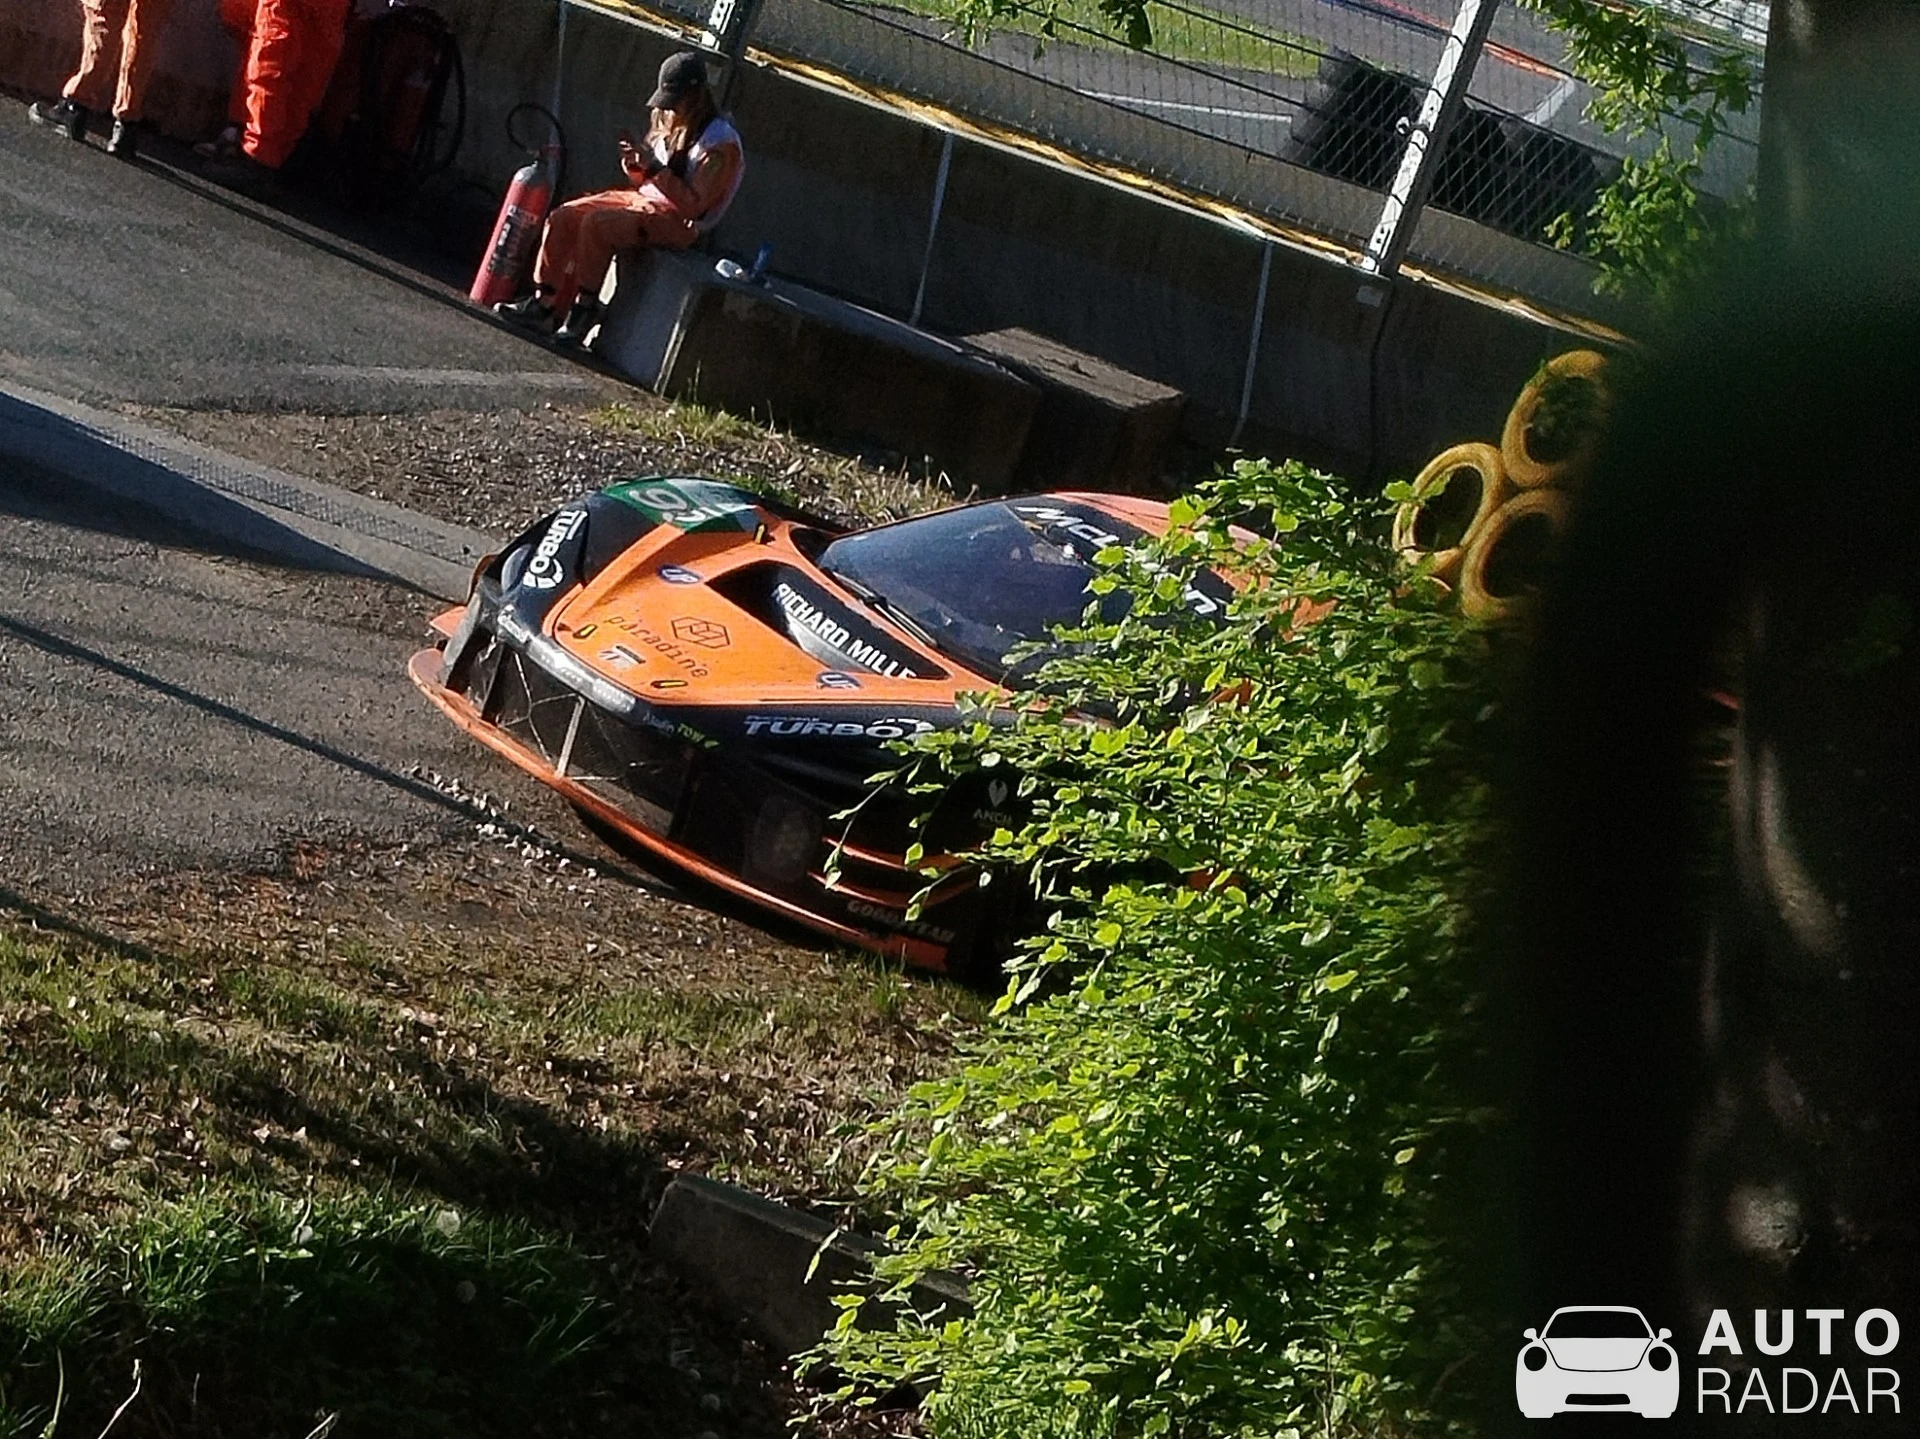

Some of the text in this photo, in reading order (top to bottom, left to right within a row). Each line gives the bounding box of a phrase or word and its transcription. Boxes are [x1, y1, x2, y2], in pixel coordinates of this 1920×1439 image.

[529, 509, 582, 575] TURBO
[772, 583, 850, 649] RICHARD
[743, 720, 903, 739] TURBO
